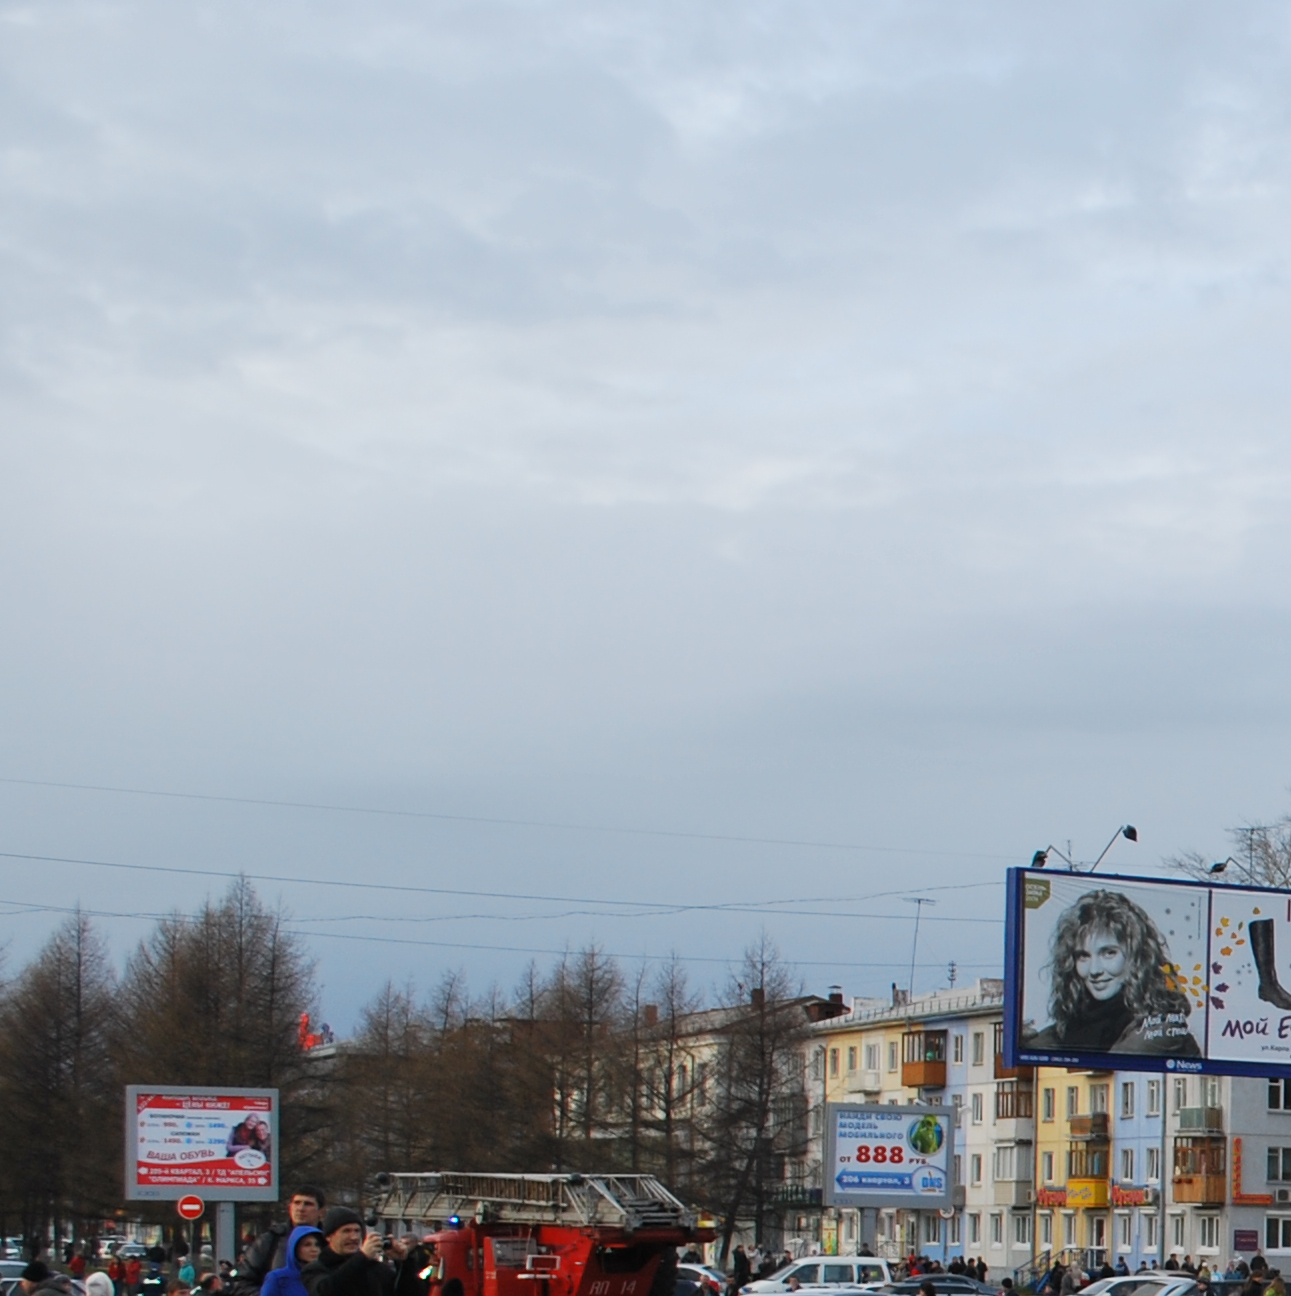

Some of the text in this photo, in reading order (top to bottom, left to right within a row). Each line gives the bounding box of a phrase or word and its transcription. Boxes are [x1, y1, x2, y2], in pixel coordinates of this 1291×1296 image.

[1176, 1060, 1202, 1070] News
[180, 1149, 215, 1160] ОБУВЬ
[856, 1145, 904, 1163] 888
[921, 1176, 942, 1189] DNS
